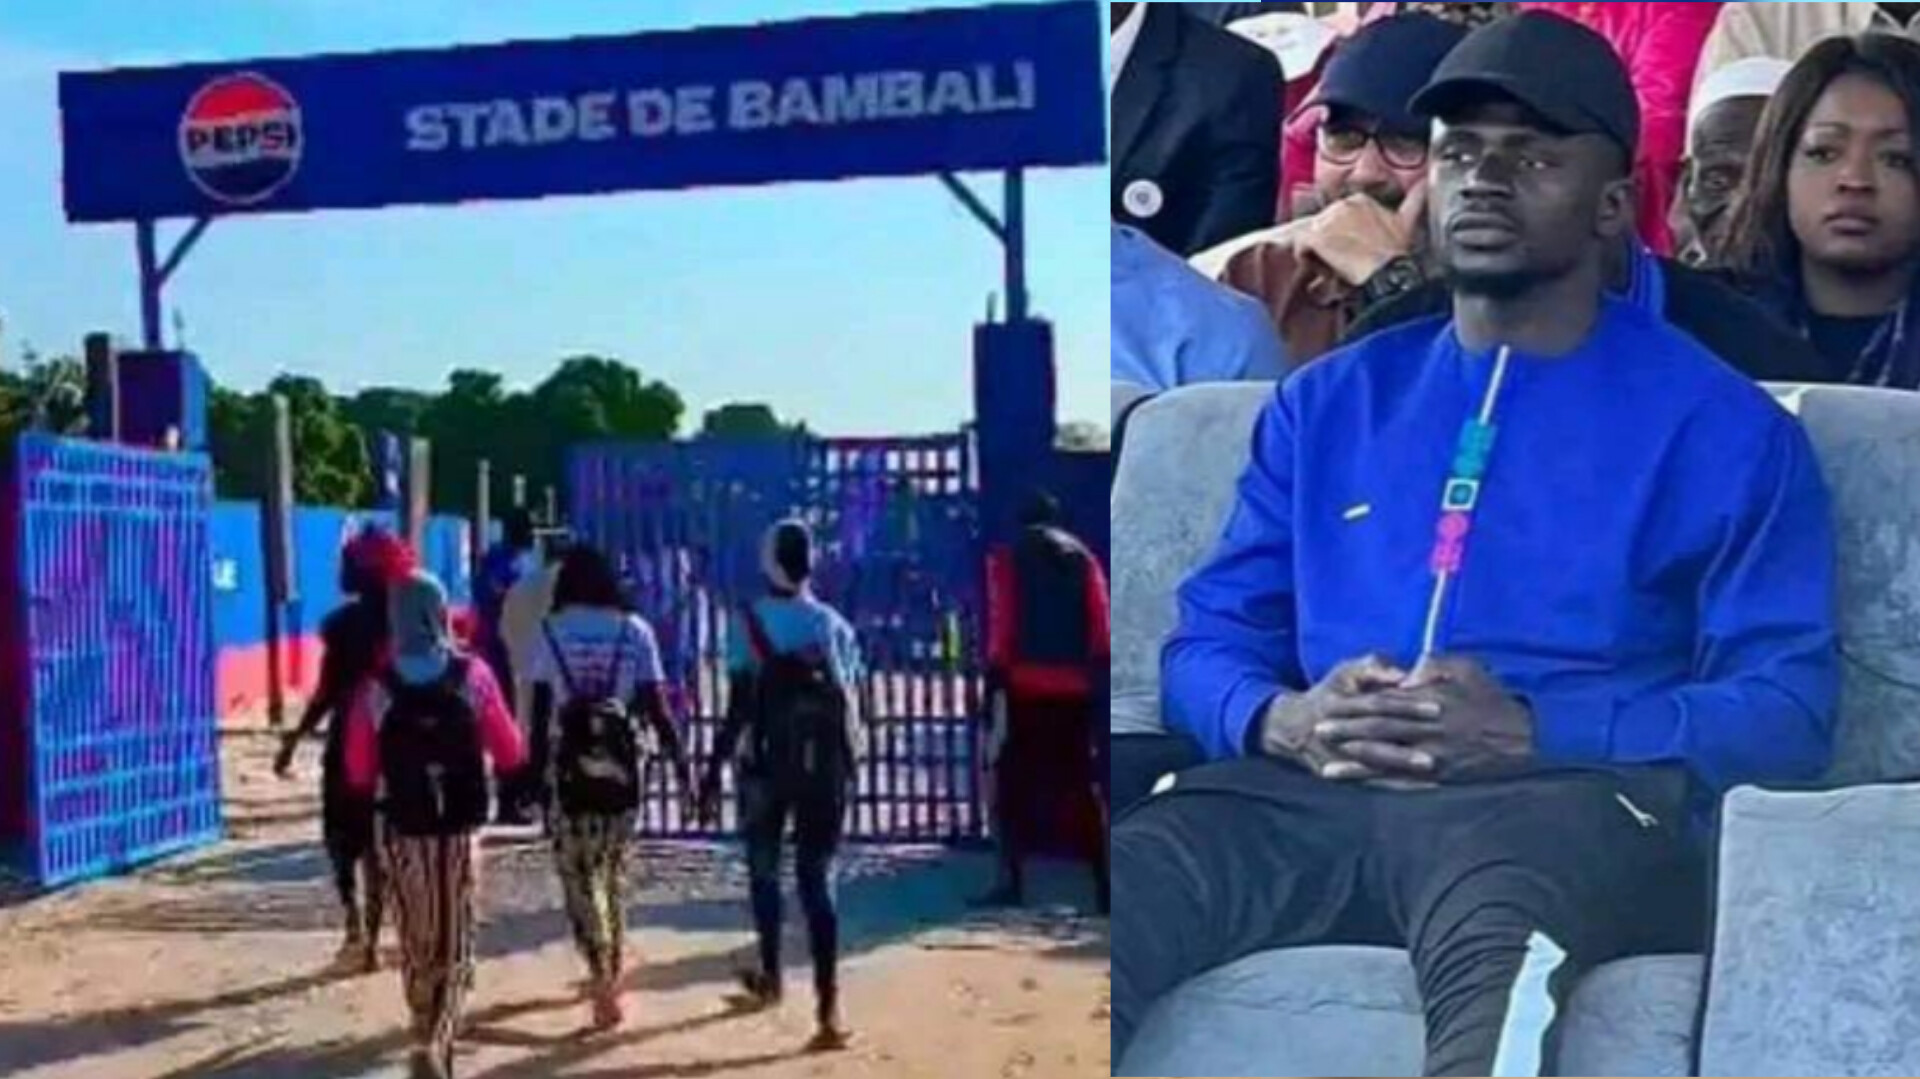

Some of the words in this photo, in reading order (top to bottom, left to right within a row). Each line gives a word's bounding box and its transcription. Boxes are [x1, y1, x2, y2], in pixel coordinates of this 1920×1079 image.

[404, 90, 616, 151] STADE
[626, 86, 714, 136] DE
[729, 59, 1035, 129] BAMBALI
[186, 120, 297, 154] PEPSI
